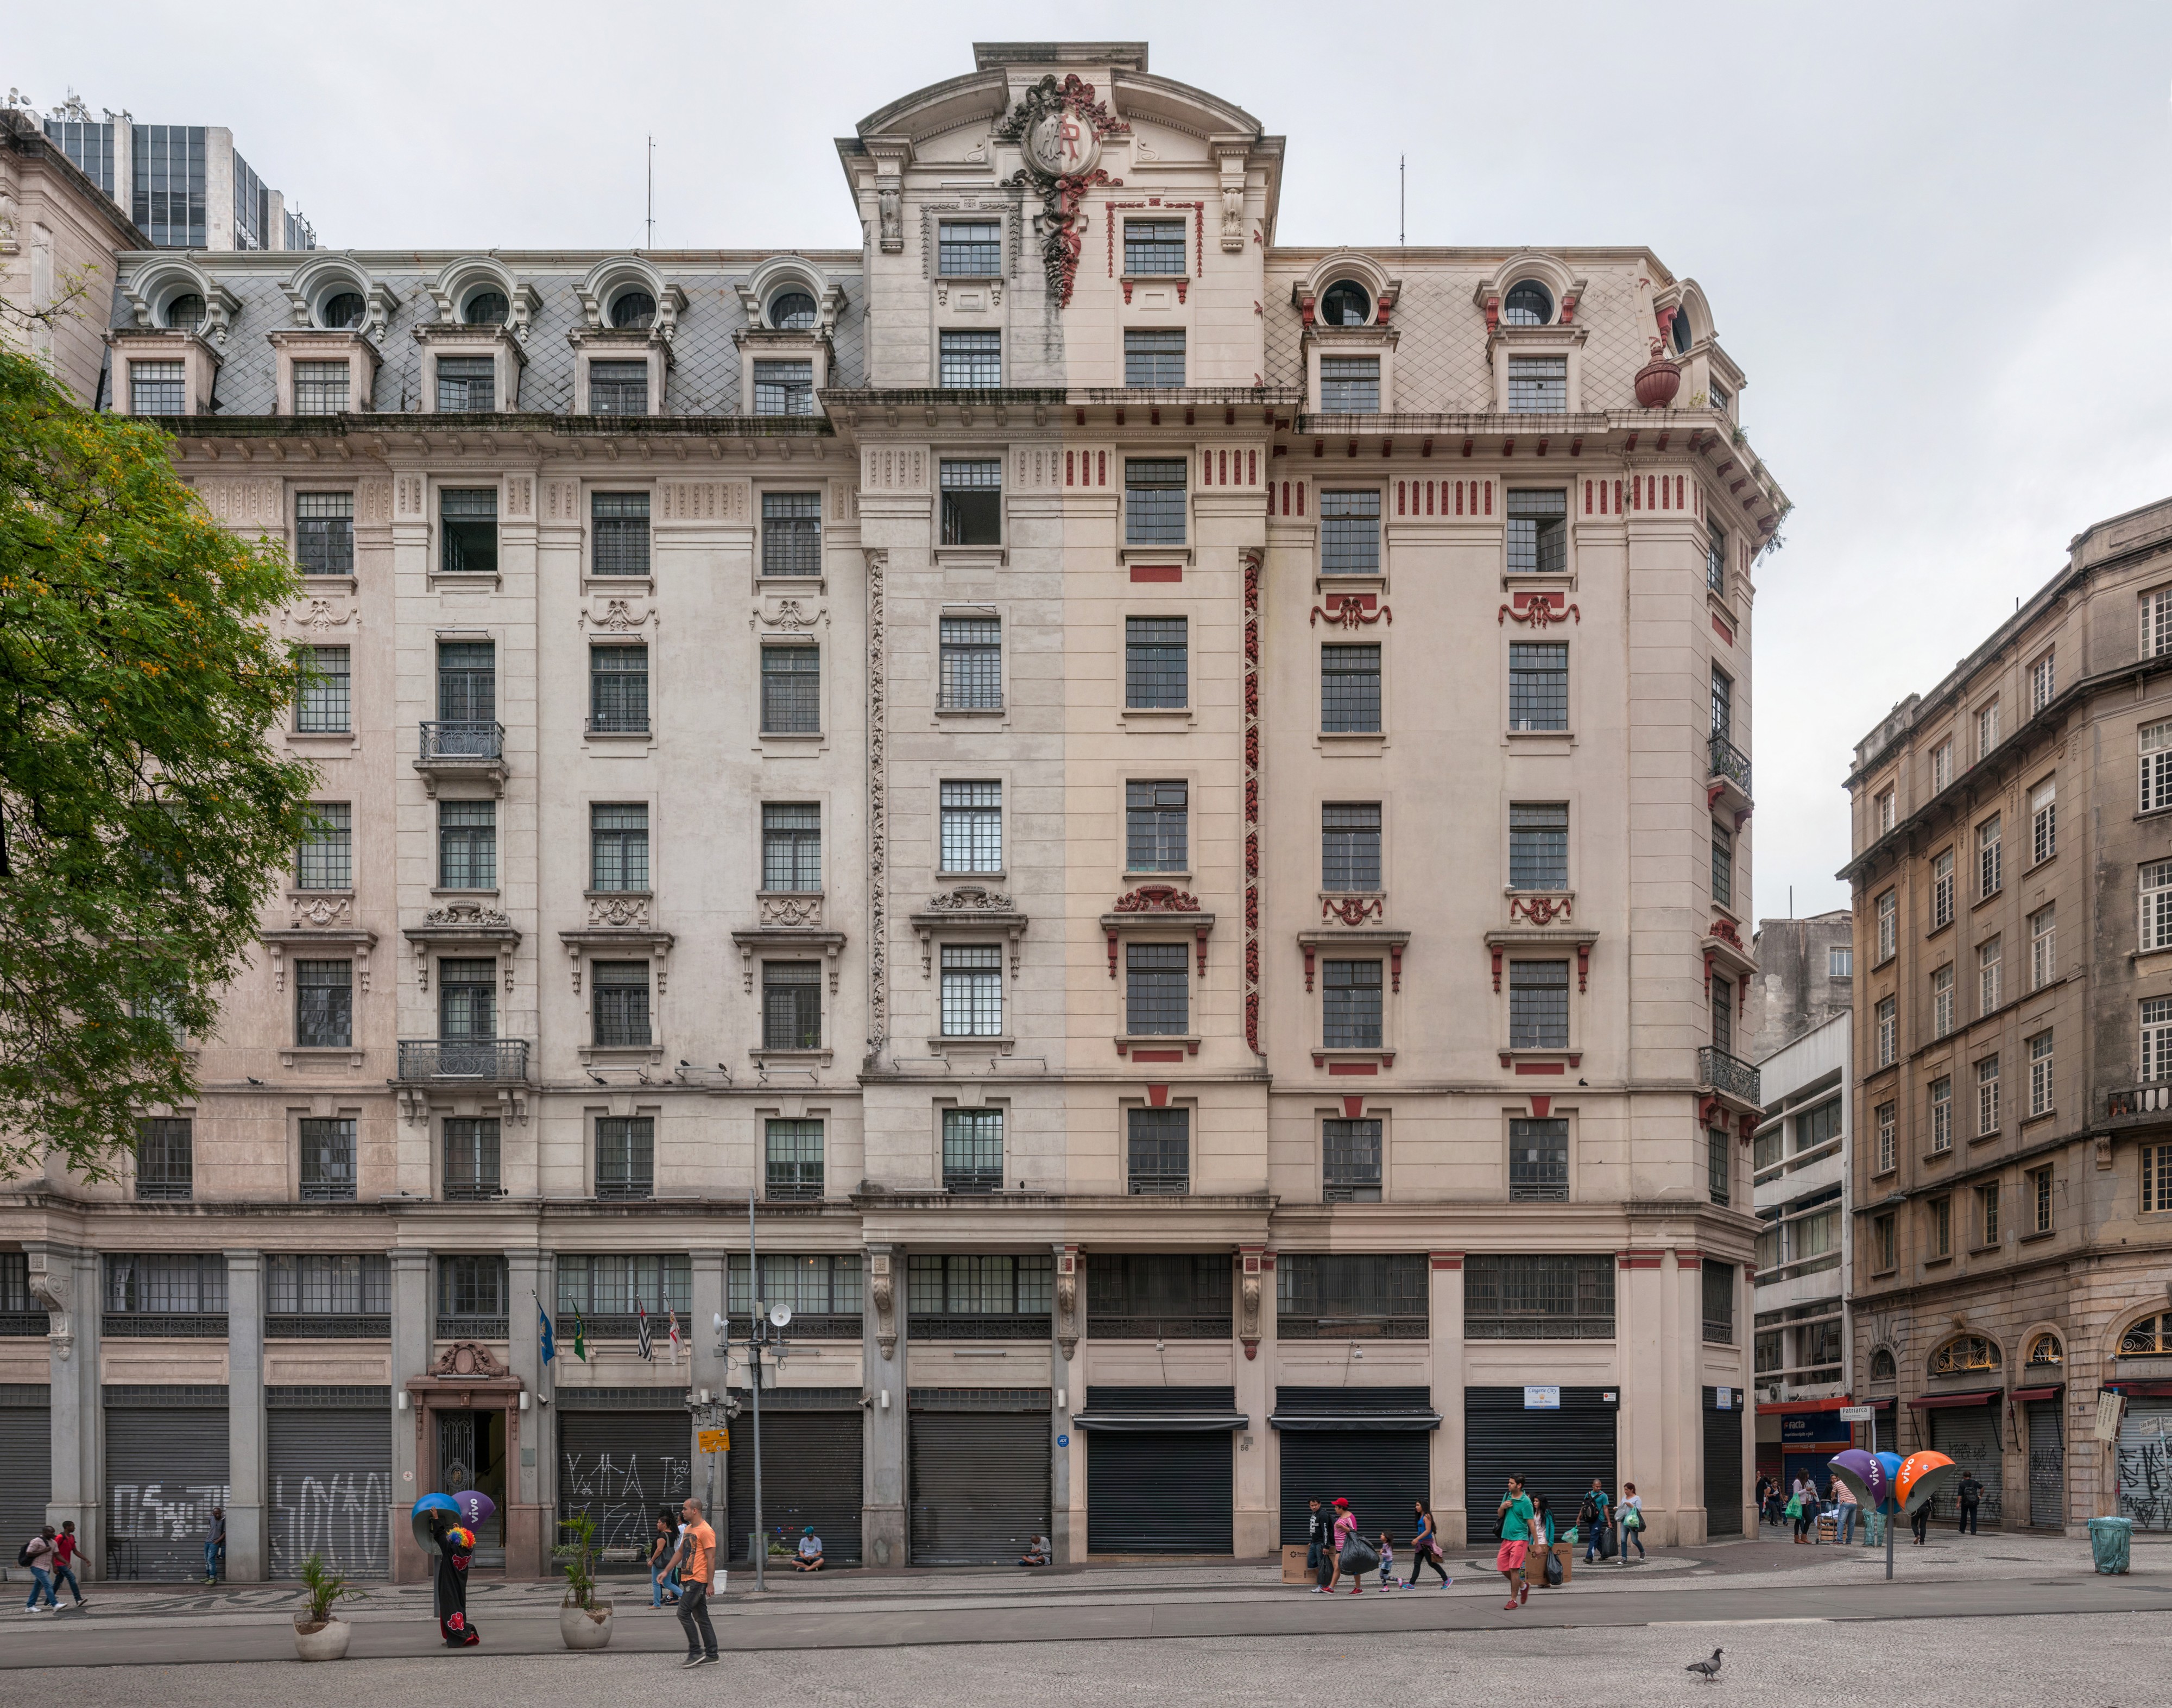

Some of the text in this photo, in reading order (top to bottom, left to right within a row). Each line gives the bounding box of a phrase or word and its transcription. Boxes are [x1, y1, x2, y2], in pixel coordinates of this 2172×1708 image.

[1869, 1459, 1879, 1486] vivo
[1902, 1458, 1915, 1484] vivo
[468, 1498, 478, 1523] vivo
